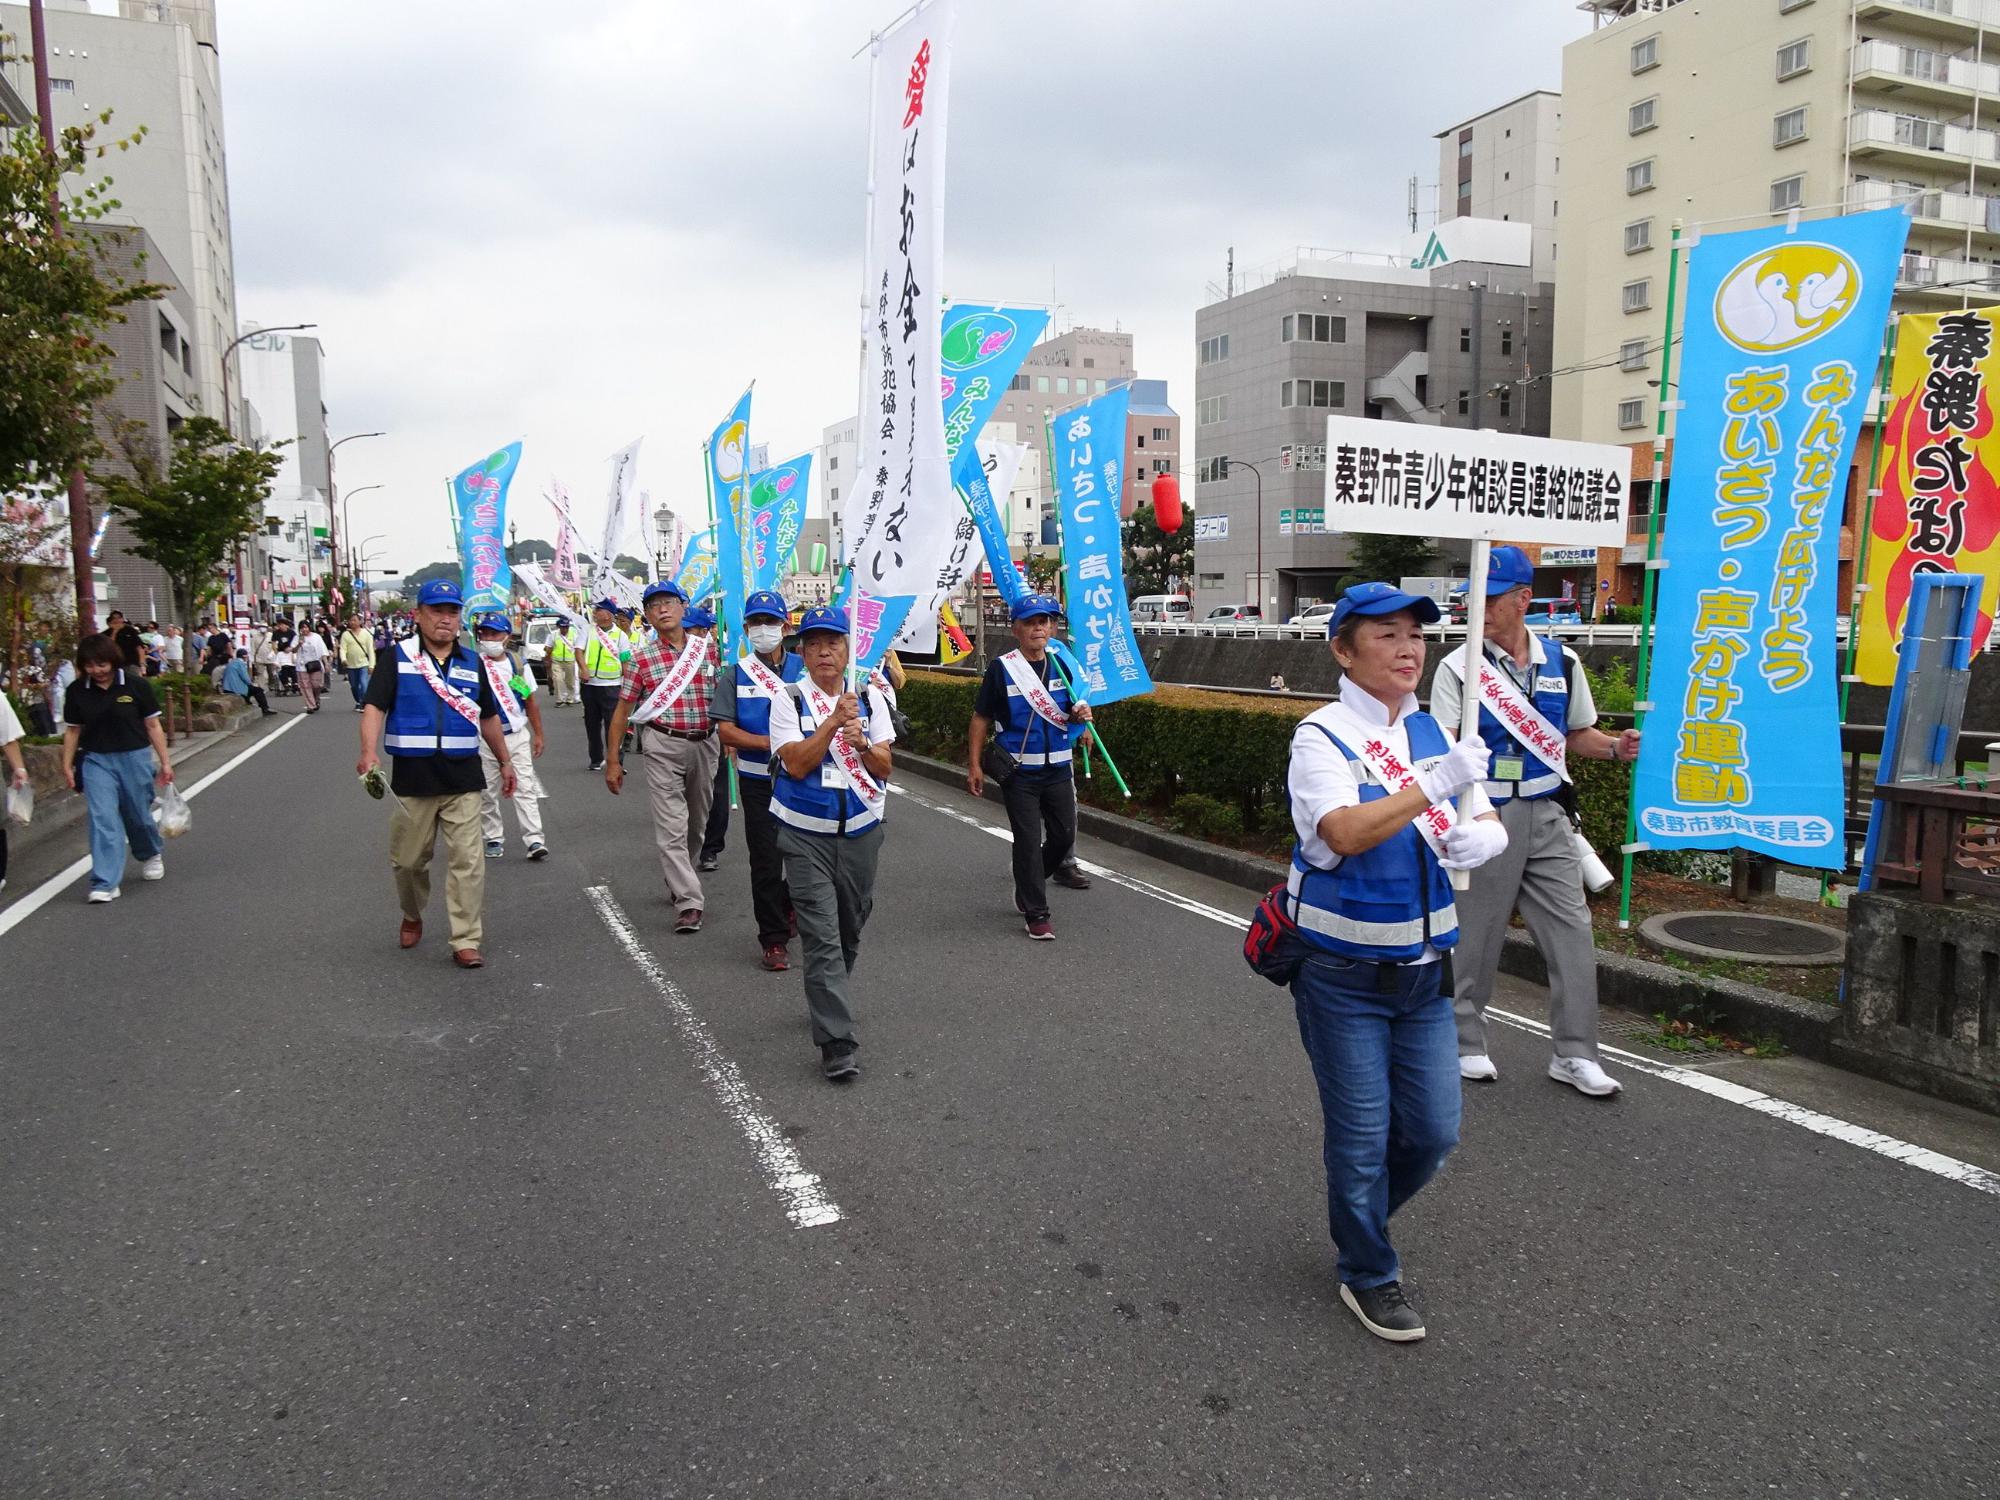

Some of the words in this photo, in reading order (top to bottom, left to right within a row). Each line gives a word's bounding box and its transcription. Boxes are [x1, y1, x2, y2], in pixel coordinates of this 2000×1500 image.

[1335, 442, 1621, 524] 秦野市青少年相談員連絡協議会
[1674, 365, 1788, 806] あいさつ・声かけ運動
[1762, 363, 1855, 692] みんなで広げよう
[1647, 811, 1828, 842] 秦野市教育委員会
